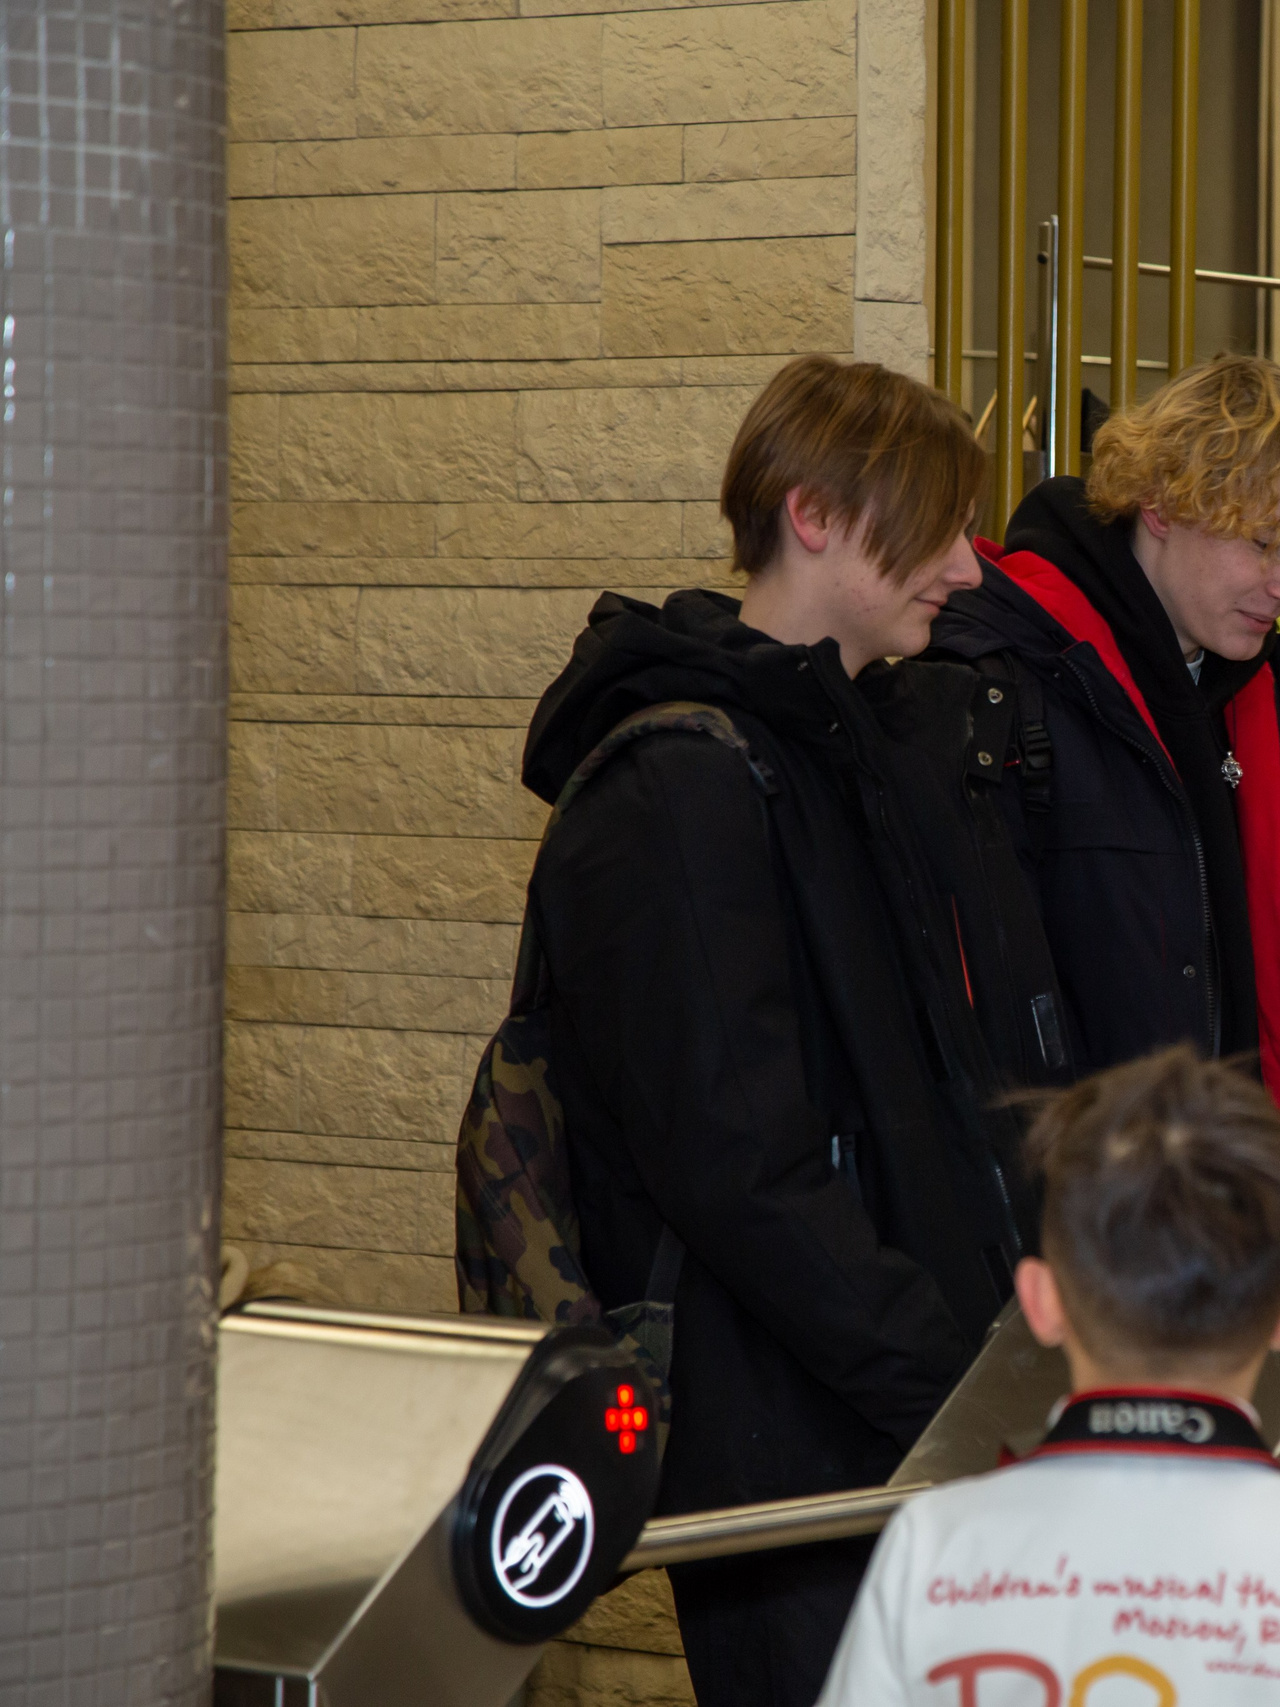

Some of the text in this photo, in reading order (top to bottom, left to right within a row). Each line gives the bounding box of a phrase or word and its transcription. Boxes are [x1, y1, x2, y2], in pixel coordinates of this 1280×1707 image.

[1089, 1402, 1216, 1444] Canon
[927, 1554, 1081, 1606] Children's
[1093, 1570, 1227, 1606] musical
